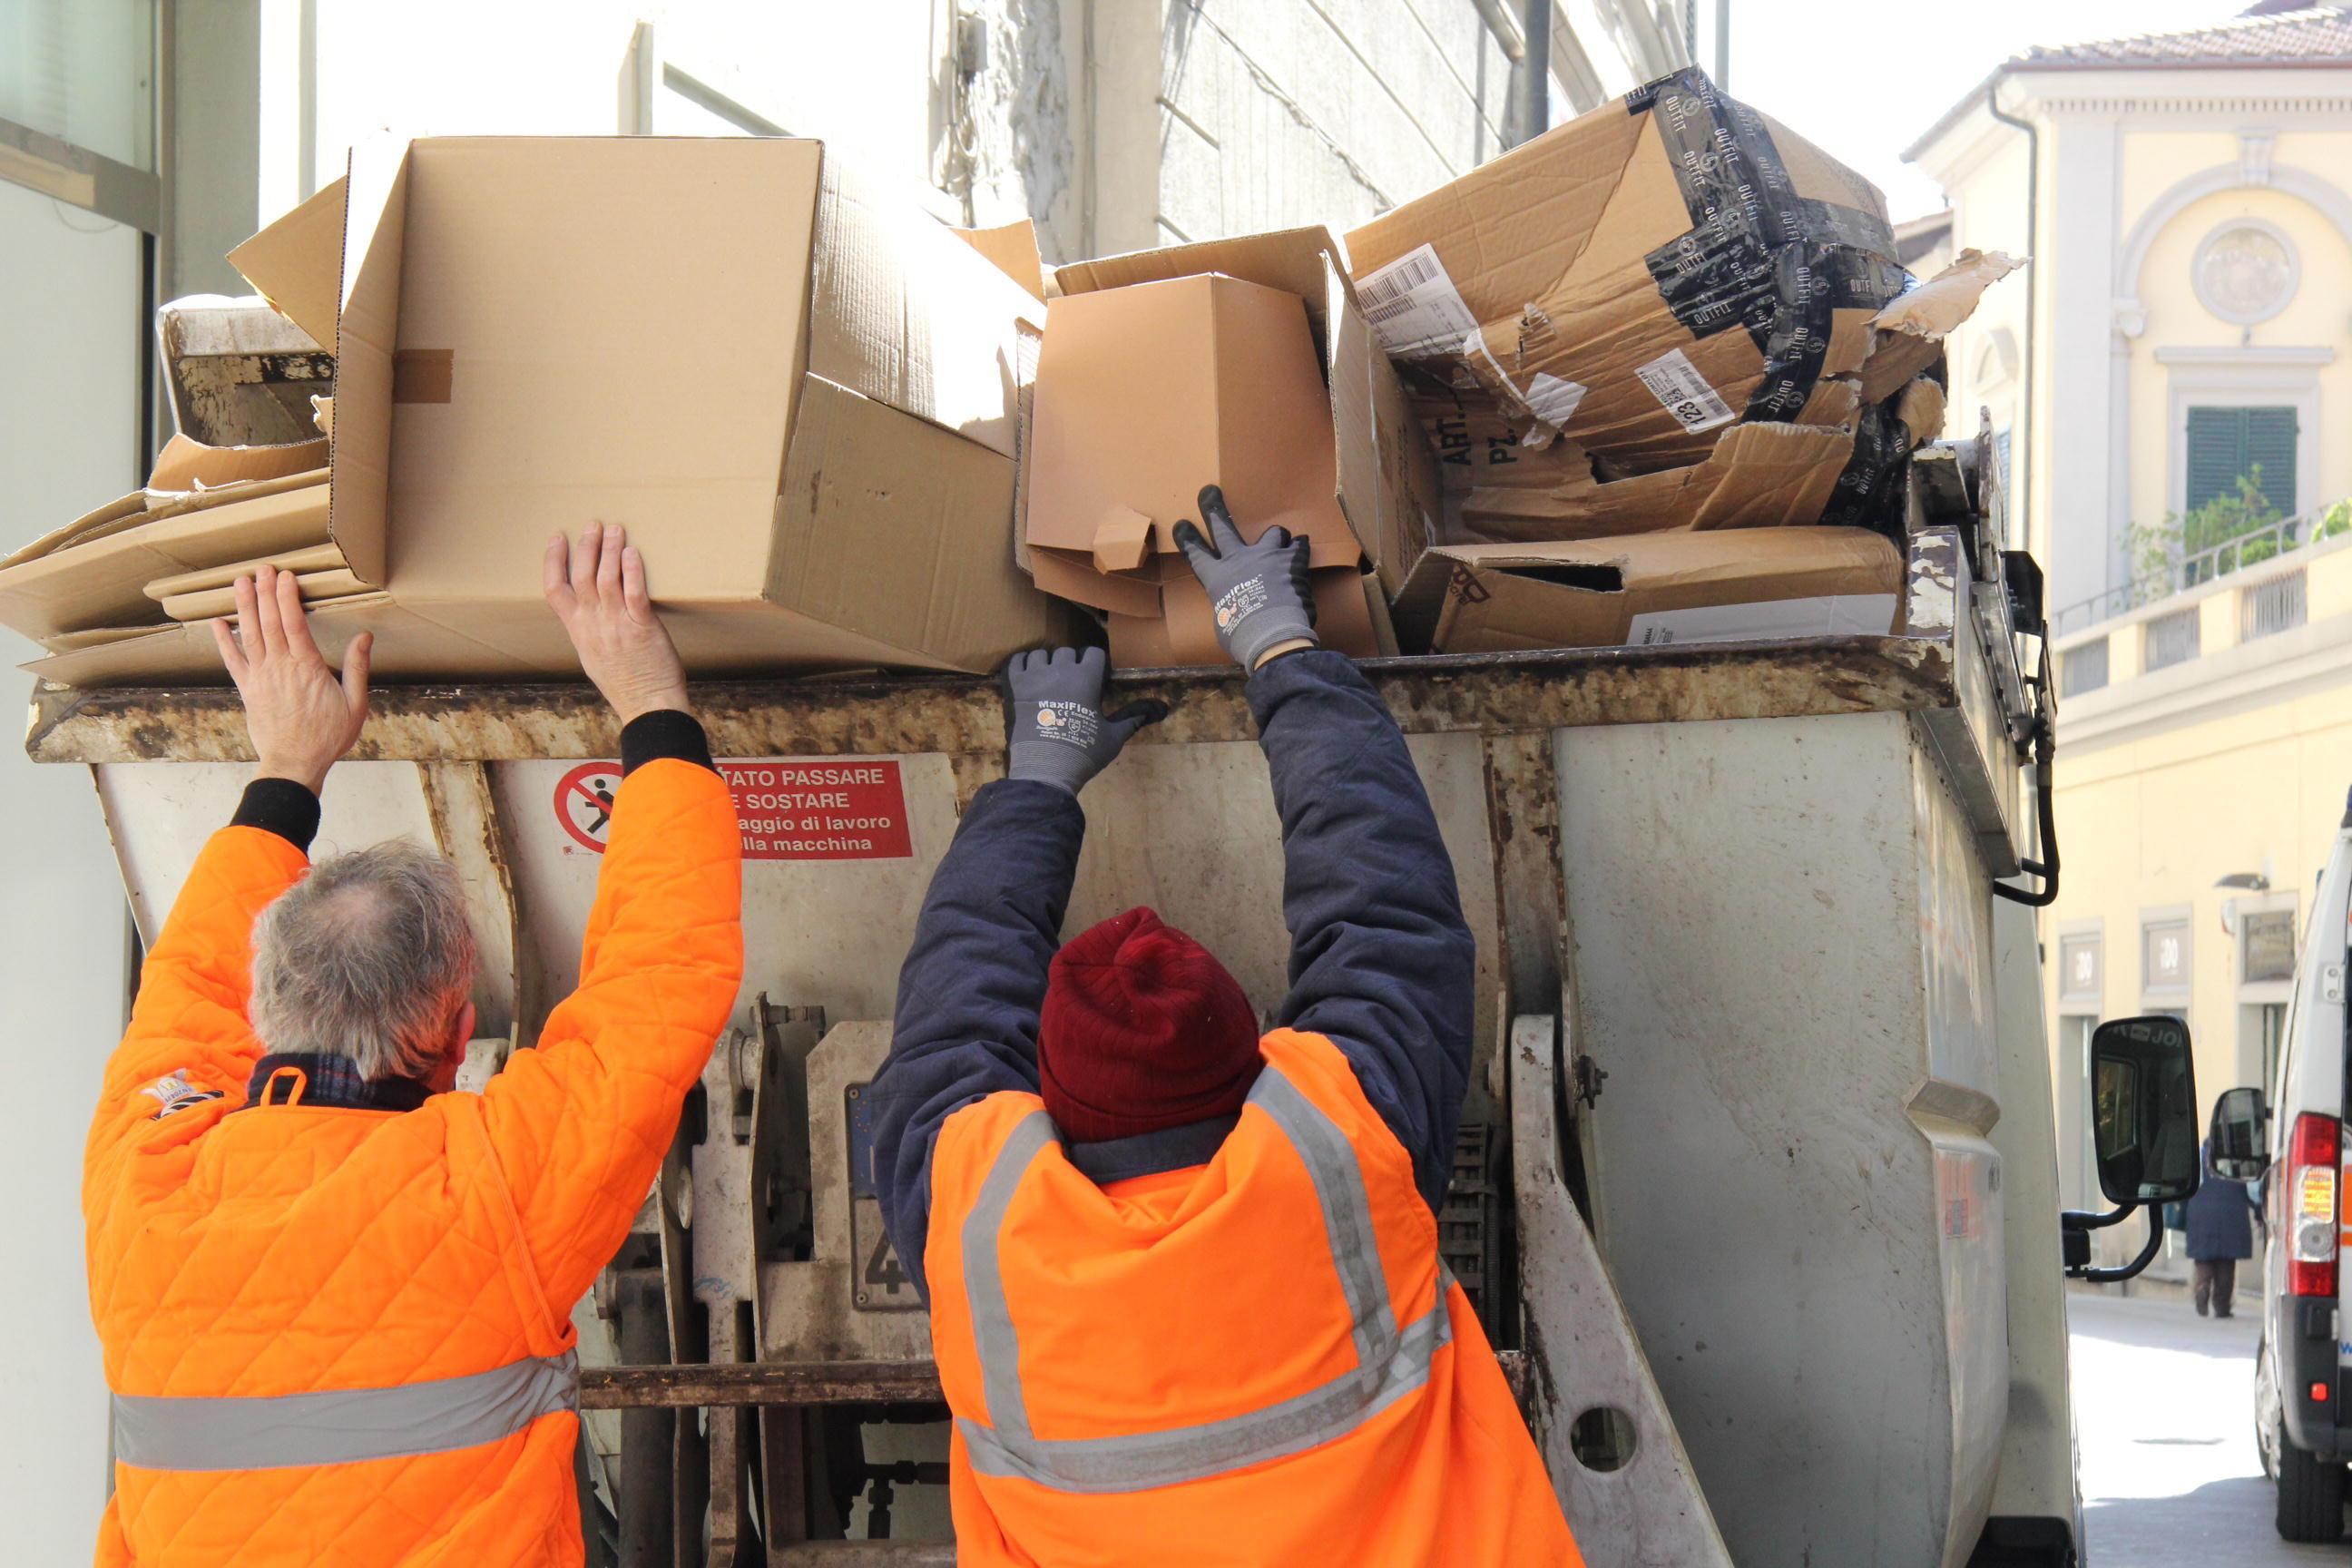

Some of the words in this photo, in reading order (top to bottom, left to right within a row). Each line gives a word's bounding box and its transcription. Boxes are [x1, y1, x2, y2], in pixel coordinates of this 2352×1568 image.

[1666, 95, 1687, 132] OUTFIT
[1714, 128, 1740, 163] OUTFIT
[1683, 151, 1706, 187] OUTFIT
[1705, 206, 1728, 243] OUTFIT
[1730, 261, 1751, 291] OUTFIT
[1796, 267, 1811, 305] OUTFIT
[1694, 302, 1732, 325] OUTFIT
[1788, 327, 1808, 360] OUTFIT
[1768, 379, 1794, 413] OUTFIT
[1678, 401, 1707, 425] 123
[1214, 575, 1260, 612] MaxiFlex
[1038, 701, 1096, 719] MaxiFlex
[782, 769, 885, 786] PASSARE
[747, 792, 850, 809] SOSTARE
[738, 817, 795, 833] aggio
[801, 817, 819, 830] di
[827, 816, 891, 830] lavoro
[740, 837, 767, 851] lla
[774, 836, 872, 851] macchina
[865, 1227, 910, 1294] 4
